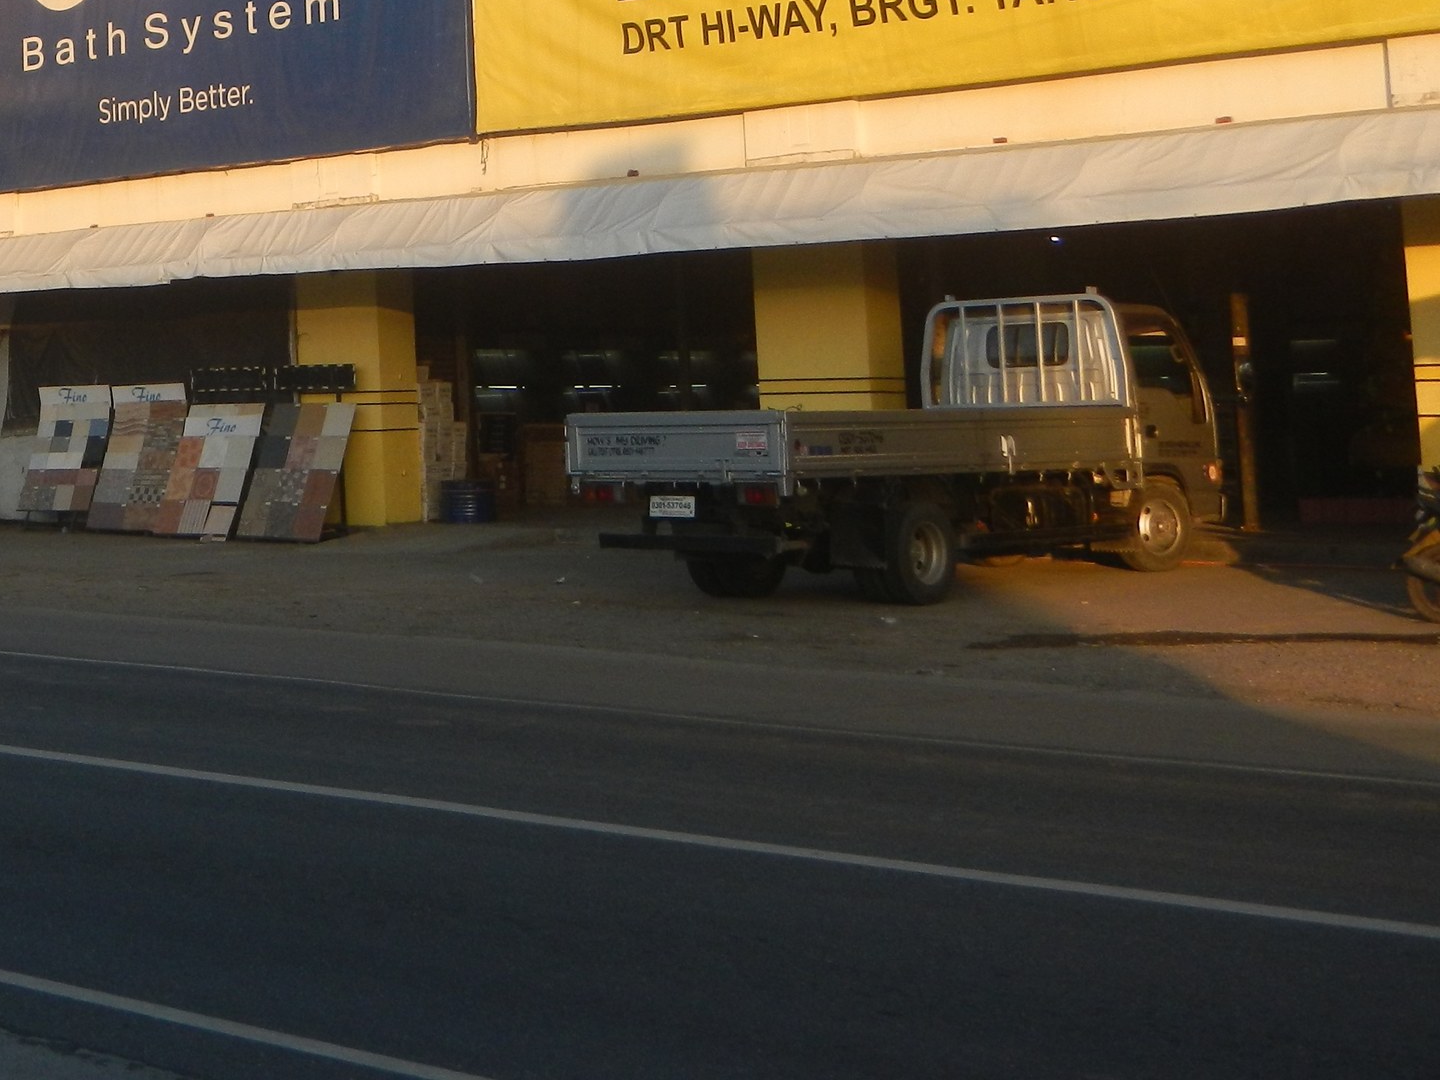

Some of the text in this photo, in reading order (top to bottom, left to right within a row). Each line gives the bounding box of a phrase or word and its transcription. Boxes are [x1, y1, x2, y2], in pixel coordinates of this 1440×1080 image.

[22, 22, 126, 72] Bath
[622, 15, 689, 56] DRT
[98, 84, 254, 124] Simply Better.
[58, 387, 87, 404] Fino
[131, 386, 160, 403] Fino
[207, 418, 236, 435] Fino
